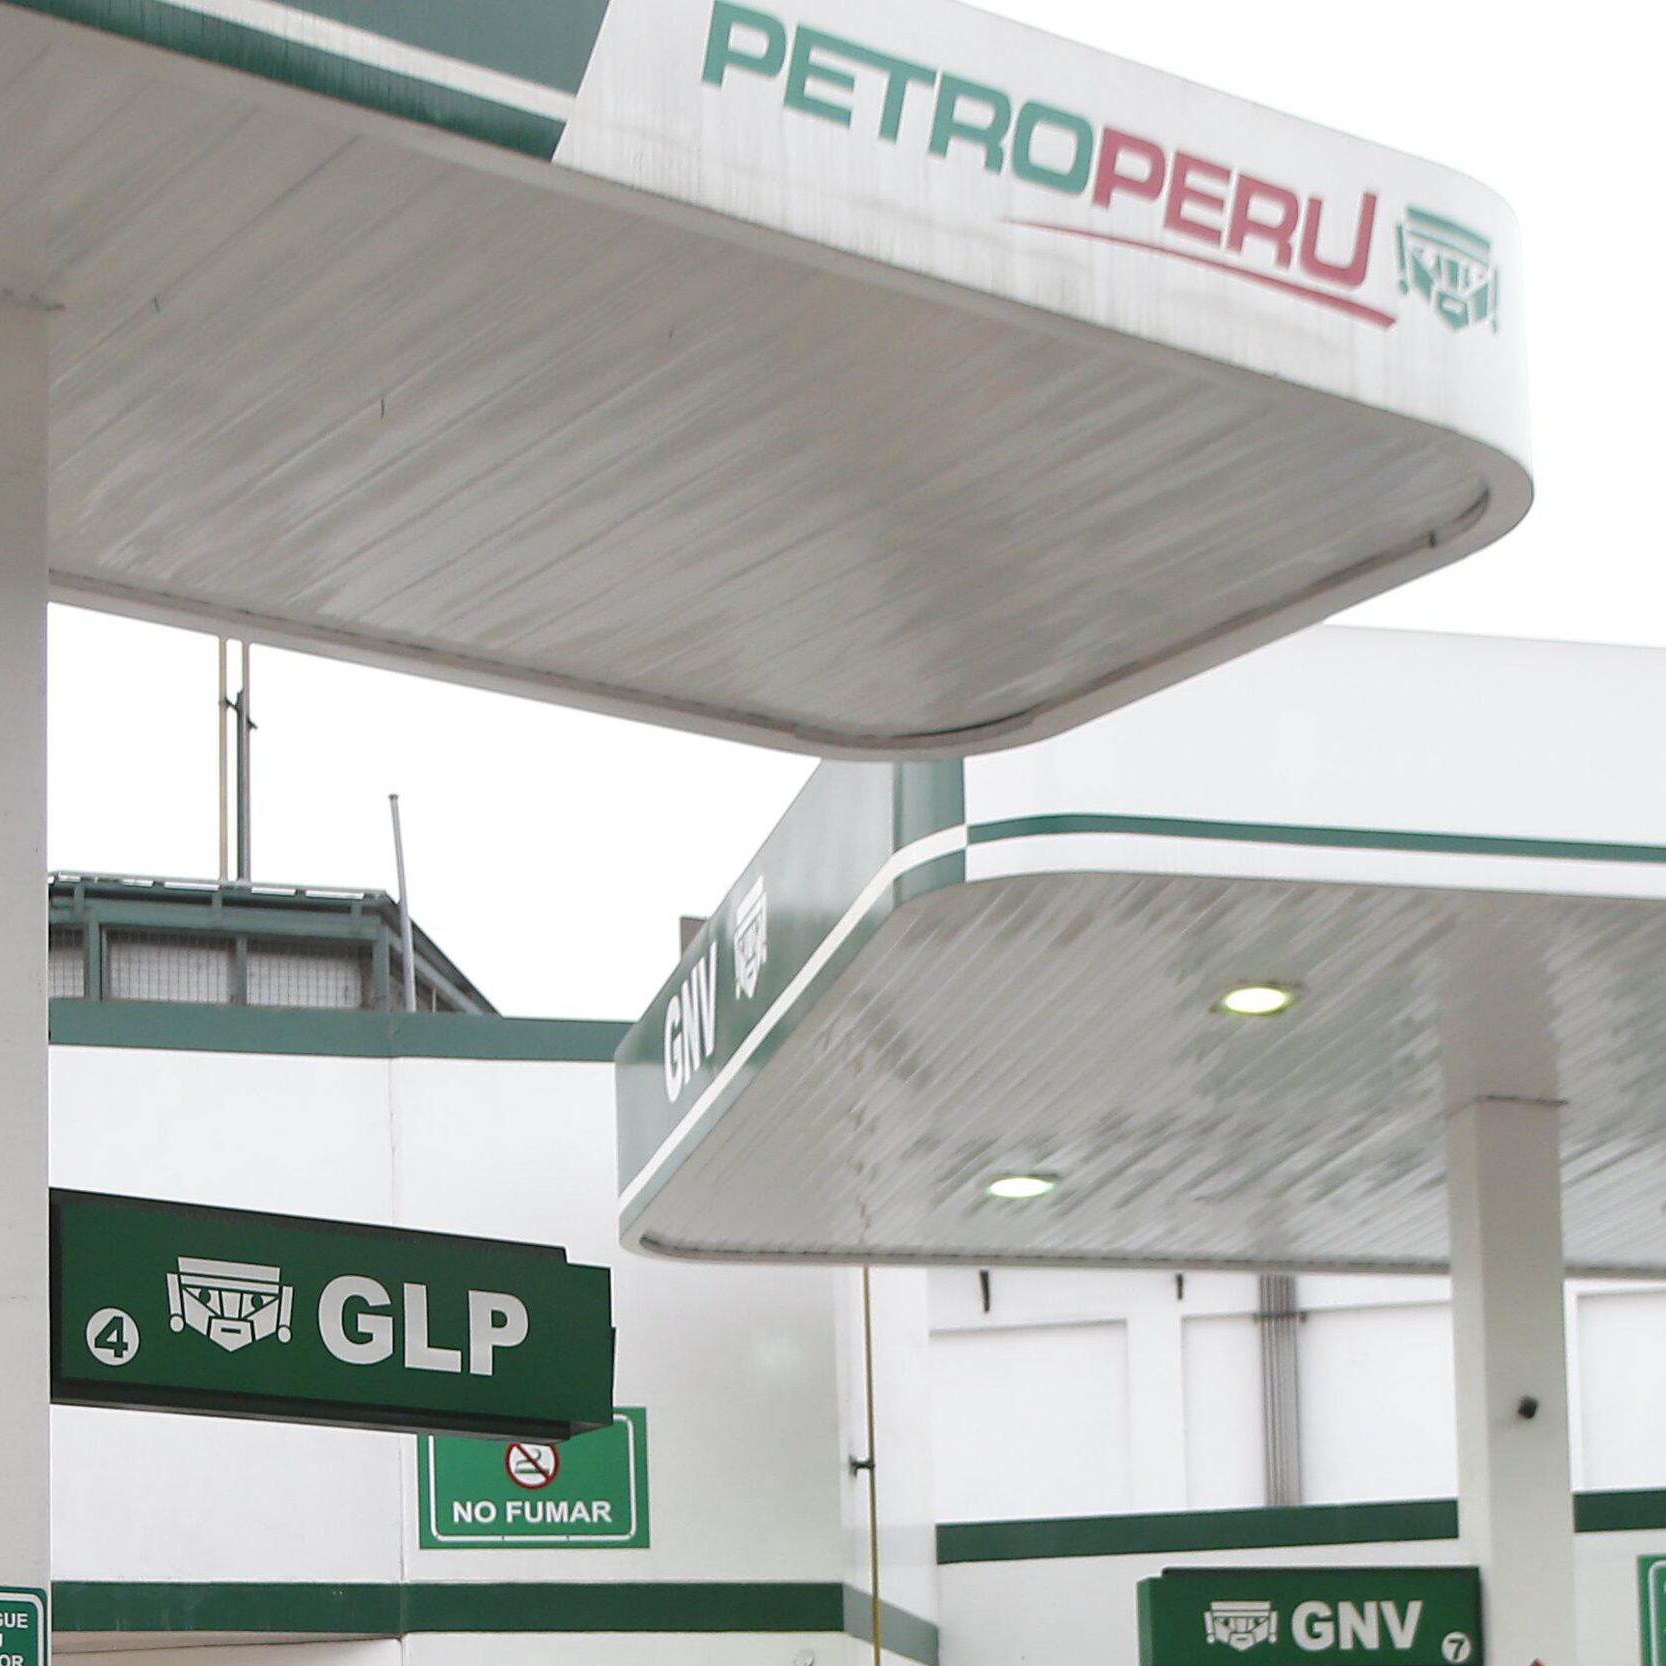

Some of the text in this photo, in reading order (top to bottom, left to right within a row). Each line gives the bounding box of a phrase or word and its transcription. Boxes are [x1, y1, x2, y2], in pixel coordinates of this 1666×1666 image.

[701, 0, 1377, 290] PETROPERU
[663, 942, 718, 1102] GNV
[94, 1274, 529, 1377] 4 GLP
[453, 1500, 612, 1524] NO FUMAR
[1291, 1600, 1465, 1661] GNV 7
